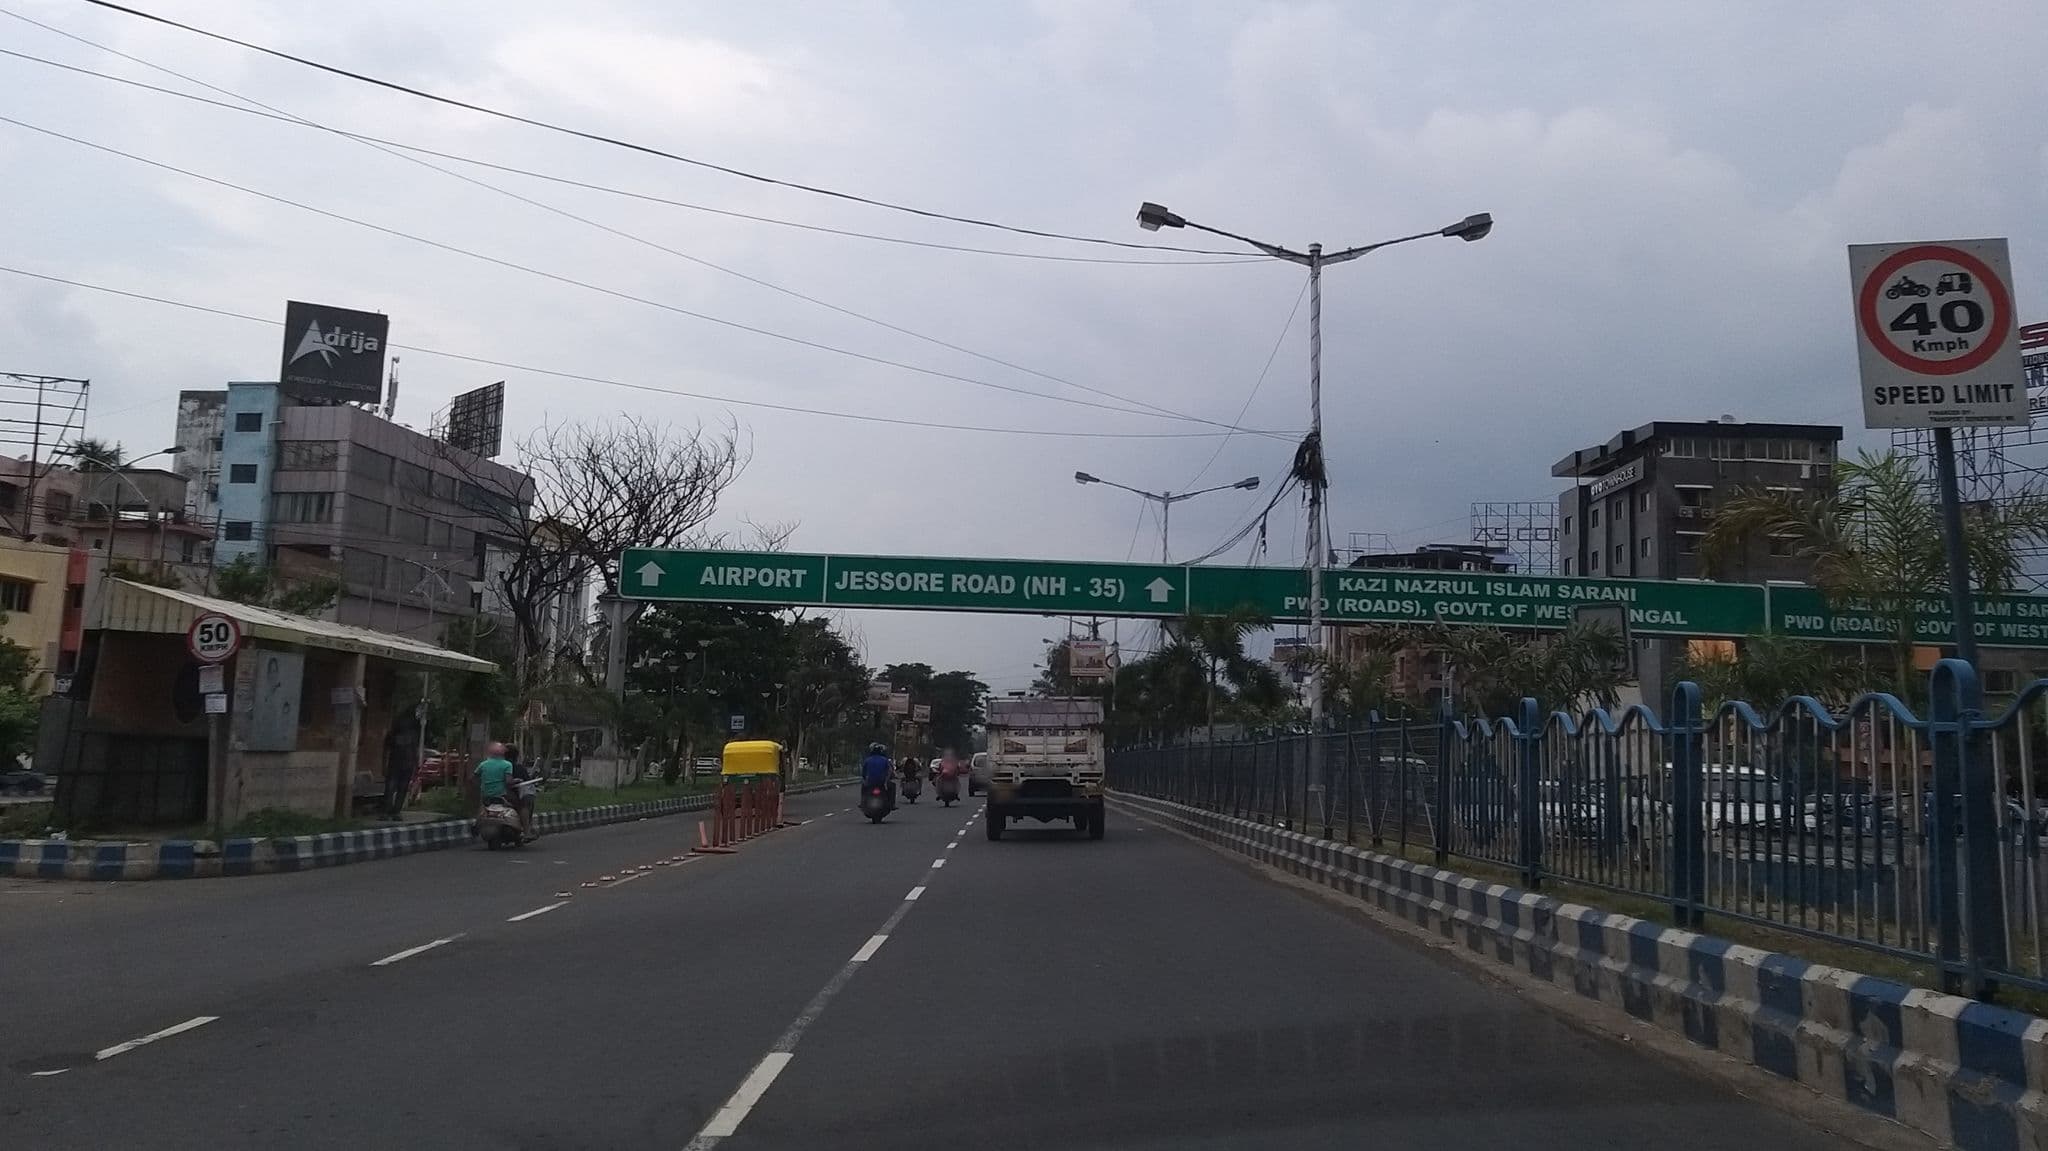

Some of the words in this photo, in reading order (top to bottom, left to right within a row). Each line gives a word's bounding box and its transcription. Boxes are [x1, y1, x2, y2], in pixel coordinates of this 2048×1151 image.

[1889, 300, 1985, 336] 40
[288, 319, 379, 369] Adrija
[1912, 336, 1970, 353] Kmph
[1874, 385, 1945, 405] SPEED
[1953, 383, 2015, 403] LIMIT
[699, 566, 808, 588] AIRPORT
[834, 570, 945, 592] JESSORE
[951, 574, 1017, 594] ROAD
[1023, 575, 1067, 600] (NH
[1088, 577, 1126, 603] 35)
[1338, 577, 1388, 592] KAZI
[1394, 578, 1479, 595] NAZRUL
[1486, 581, 1550, 598] ISLAM
[1557, 585, 1637, 602] SARANI
[1336, 598, 1428, 617] (ROADS),
[1434, 600, 1495, 616] GOVT.
[1500, 603, 1528, 618] OF
[1630, 608, 1688, 625] NGAL
[199, 622, 230, 643] 50
[1784, 614, 1825, 630] PWD
[1974, 622, 1996, 637] OF
[2000, 623, 2048, 638] WEST
